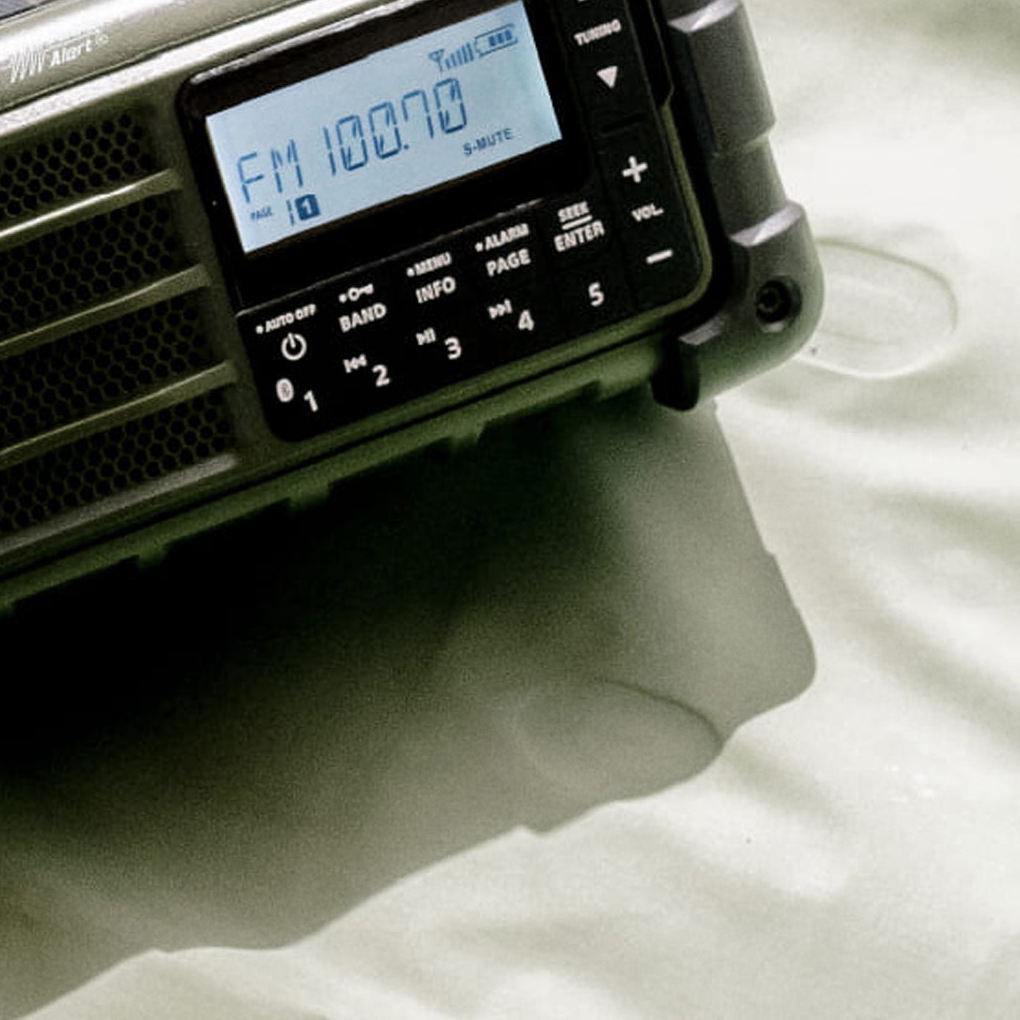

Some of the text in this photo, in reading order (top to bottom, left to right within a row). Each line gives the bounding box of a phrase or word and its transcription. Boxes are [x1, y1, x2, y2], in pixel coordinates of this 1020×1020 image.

[574, 18, 622, 46] TUNING
[237, 77, 468, 203] FM 100.70
[462, 127, 514, 157] S-MUTE
[557, 201, 590, 223] SEEK
[485, 222, 530, 251] ALARM
[554, 219, 606, 253] ENTER
[413, 251, 453, 277] MENU
[486, 247, 532, 277] PAGE
[415, 276, 457, 304] INFO
[588, 281, 605, 307] 5
[265, 311, 295, 333] AUTO
[339, 302, 387, 333] BAND
[518, 309, 535, 331] 4
[444, 336, 462, 360] 3
[372, 364, 391, 388] 2
[303, 389, 319, 413] 1
